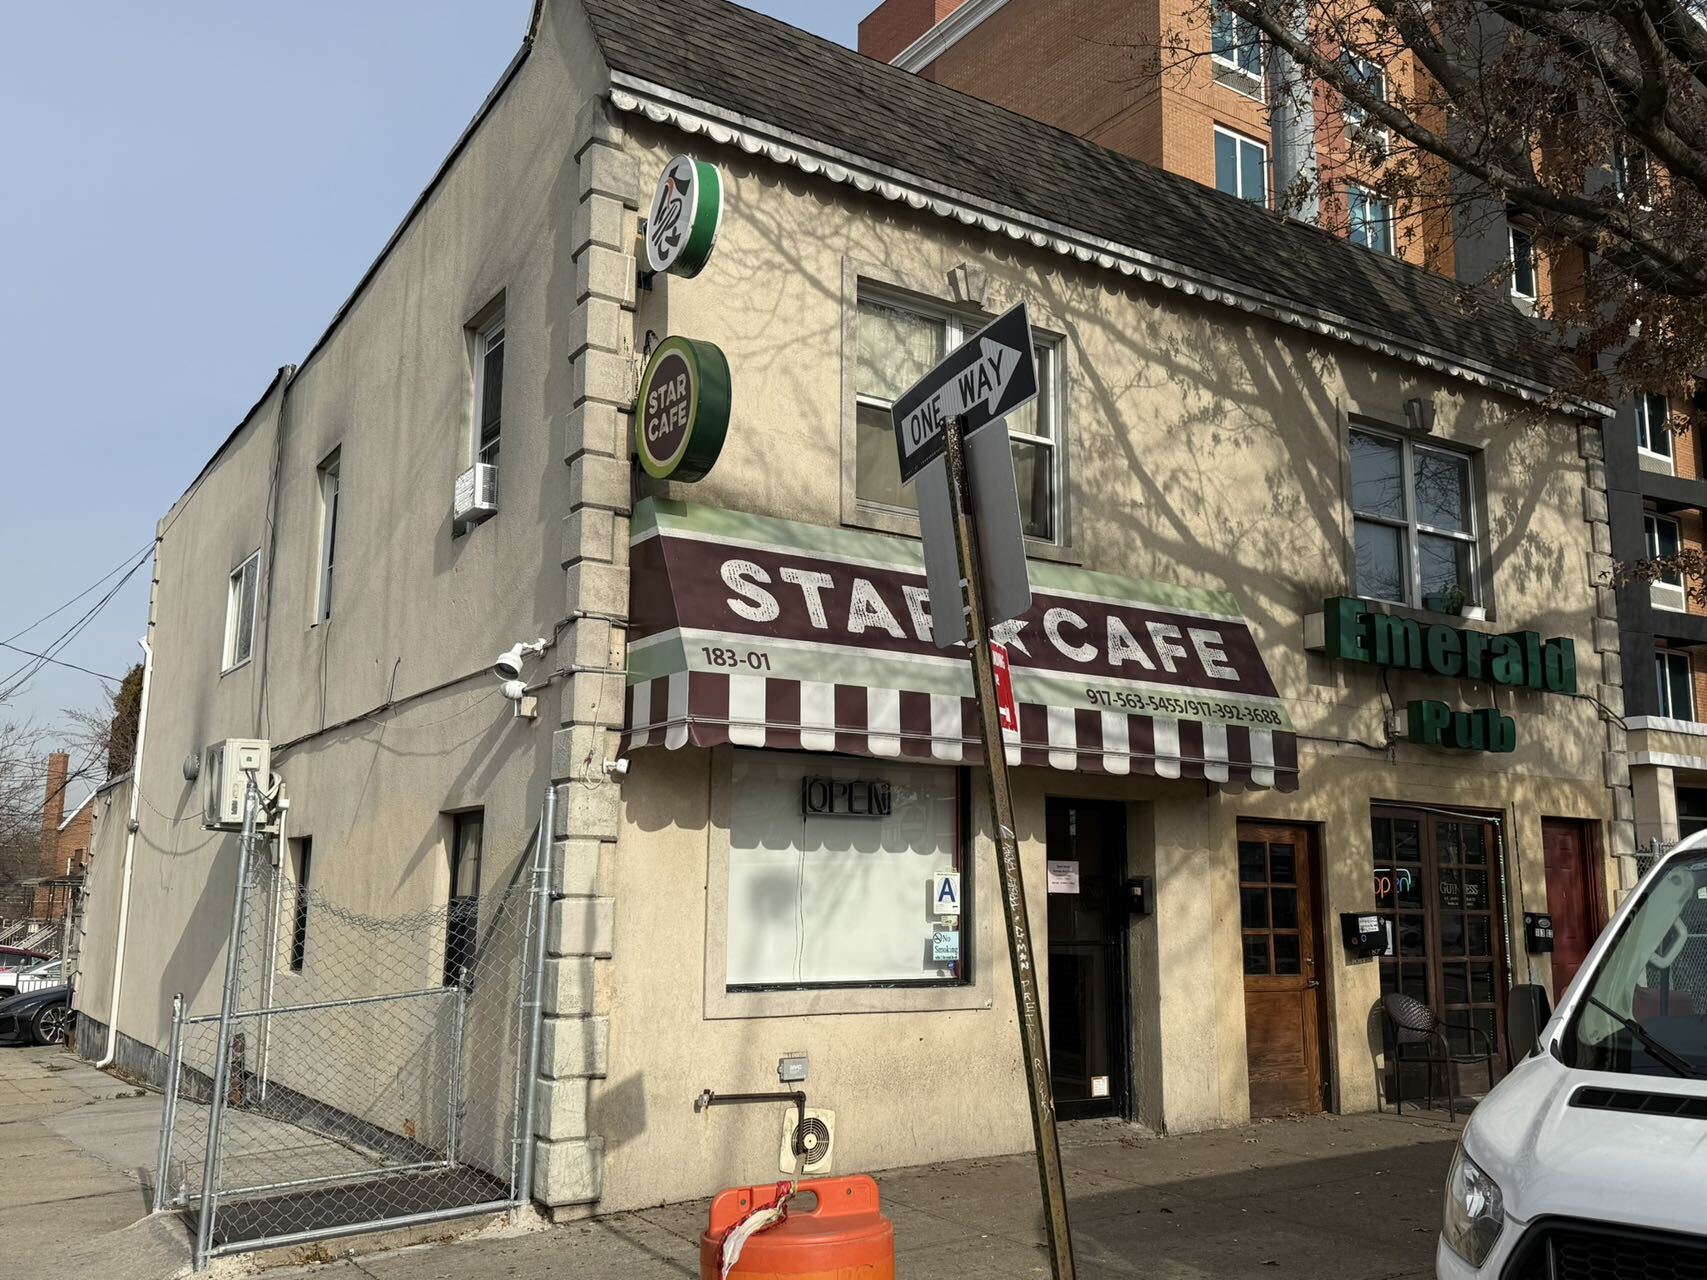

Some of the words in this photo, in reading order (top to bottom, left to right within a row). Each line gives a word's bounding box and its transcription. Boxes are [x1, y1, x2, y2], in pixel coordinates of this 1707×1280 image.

[648, 373, 687, 415] STAR
[911, 393, 946, 446] ONE
[958, 349, 1003, 409] WAY
[648, 400, 687, 442] CAFE
[701, 646, 771, 671] 183-01
[1043, 607, 1241, 681] CAFE
[1325, 596, 1577, 694] Emerald
[1086, 688, 1282, 725] 917-563-5455/917-392-3688
[1408, 700, 1516, 753] Pub
[807, 779, 891, 815] OPEN
[938, 877, 956, 903] A
[1374, 876, 1410, 899] opn
[1440, 881, 1478, 895] GUIESS
[935, 945, 958, 956] Smoking
[942, 934, 951, 943] No
